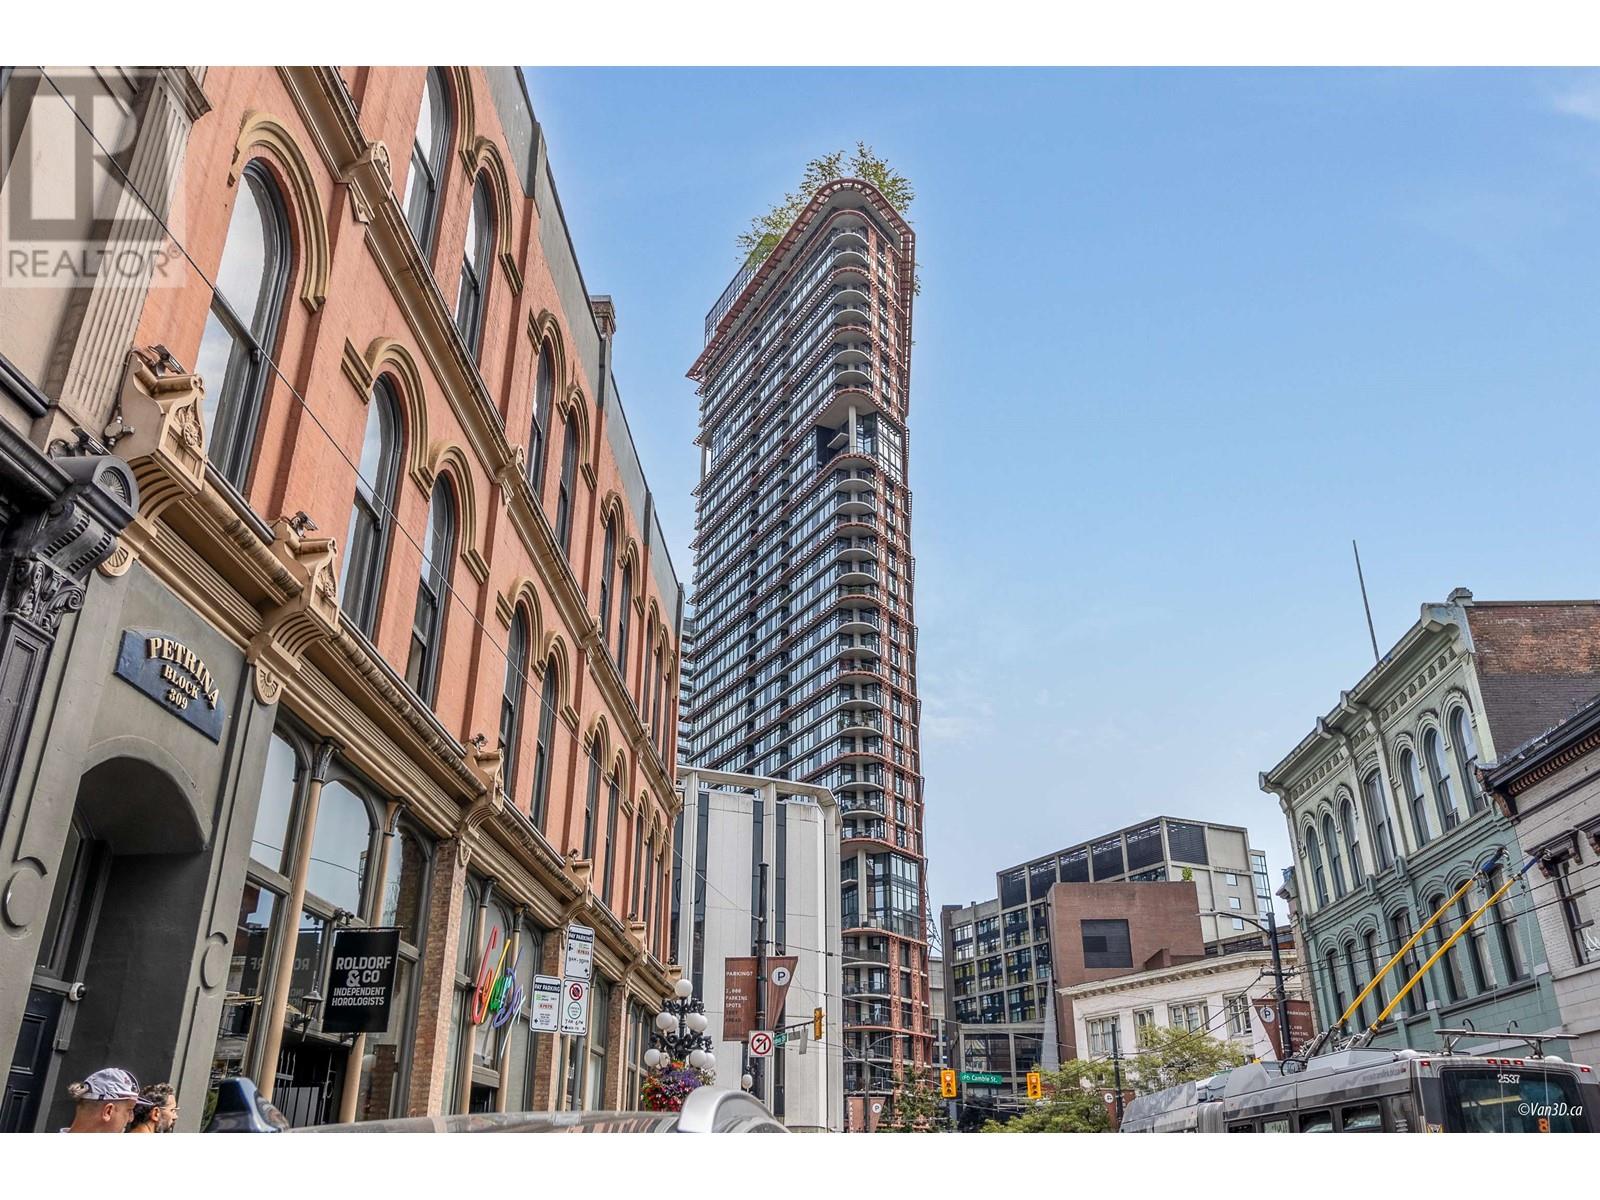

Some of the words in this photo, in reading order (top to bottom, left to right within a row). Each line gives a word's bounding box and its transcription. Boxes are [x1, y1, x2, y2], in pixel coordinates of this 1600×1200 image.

[148, 637, 219, 710] PETRINA
[163, 664, 200, 699] BLOCK
[168, 688, 188, 710] 309
[336, 957, 392, 970] ROLDORF
[346, 970, 360, 987] &
[362, 970, 380, 983] CO
[777, 972, 786, 982] P
[334, 987, 385, 996] INDEPENDENT
[542, 984, 560, 993] PARKING
[332, 997, 384, 1006] HOROLOGISTS
[1497, 1074, 1520, 1084] 2537
